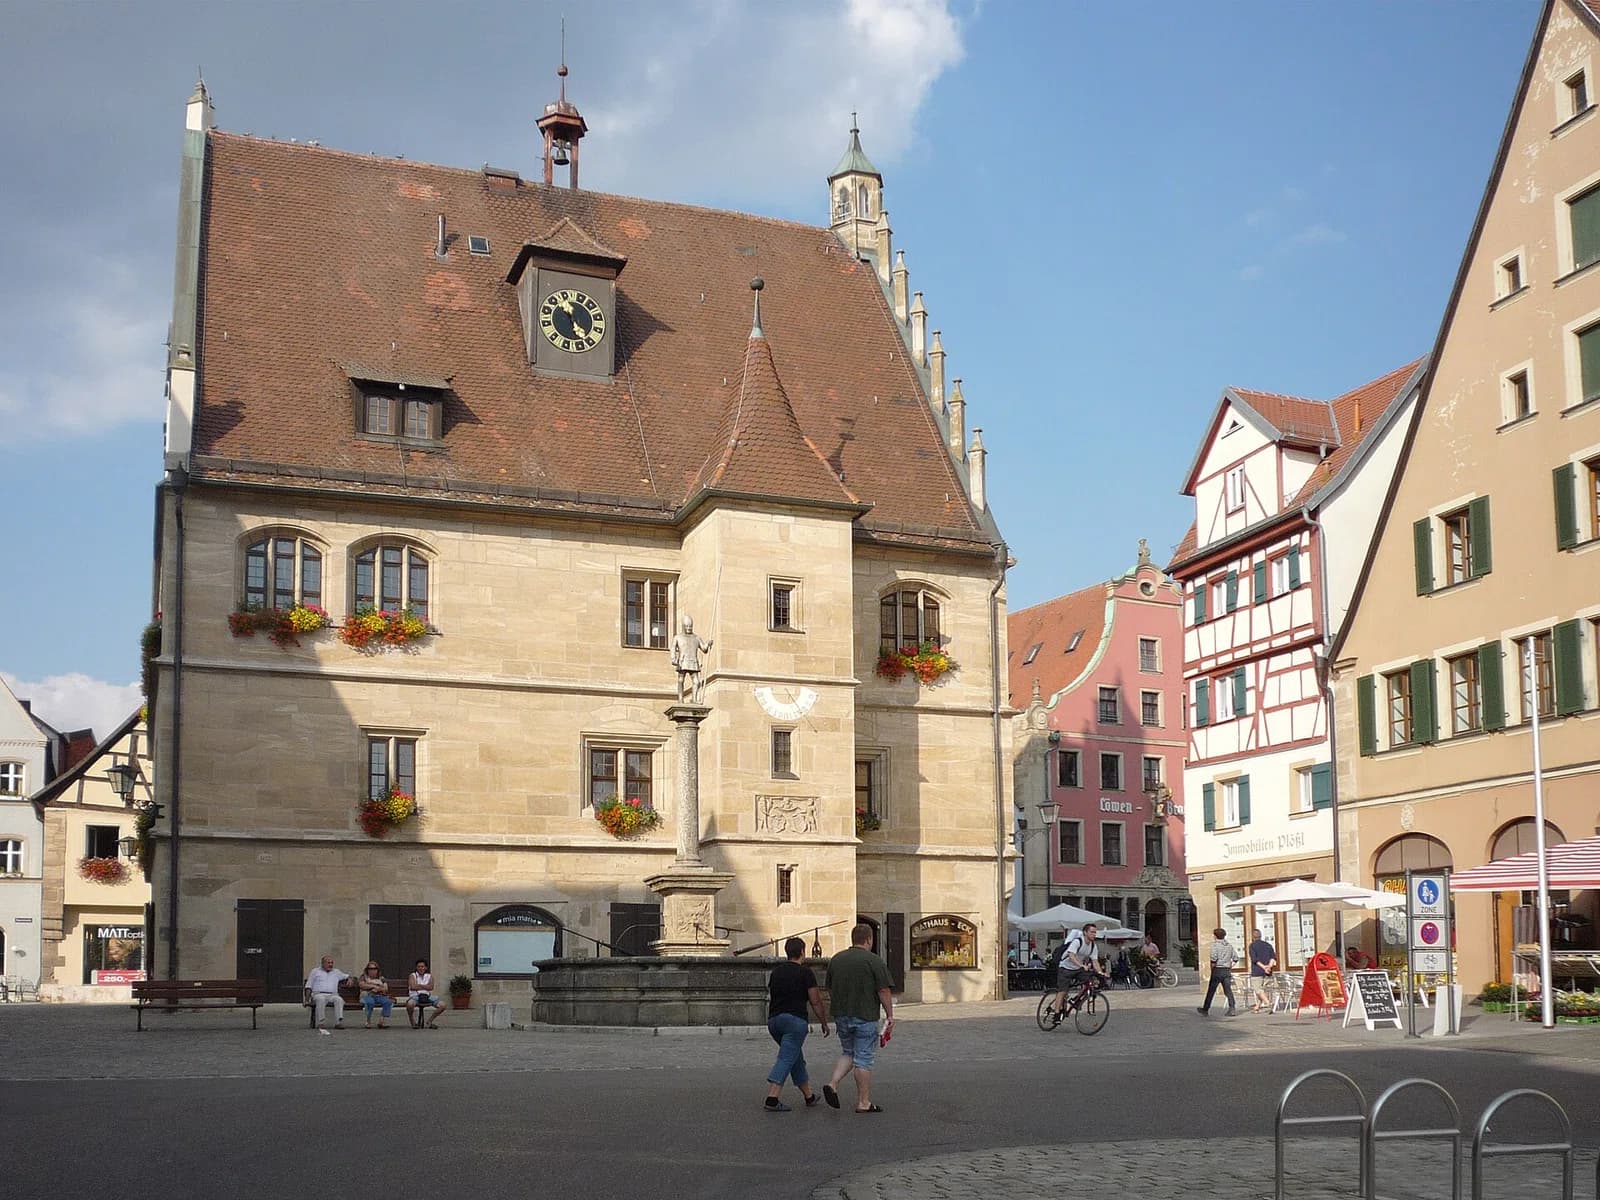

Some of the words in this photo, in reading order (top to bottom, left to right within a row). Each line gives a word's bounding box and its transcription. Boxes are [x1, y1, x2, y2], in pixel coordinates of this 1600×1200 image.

[1099, 797, 1133, 814] Löwen
[1222, 838, 1274, 859] Immobilien
[1420, 906, 1438, 914] ZONE
[502, 915, 516, 923] mia
[913, 918, 949, 934] RATHAUS
